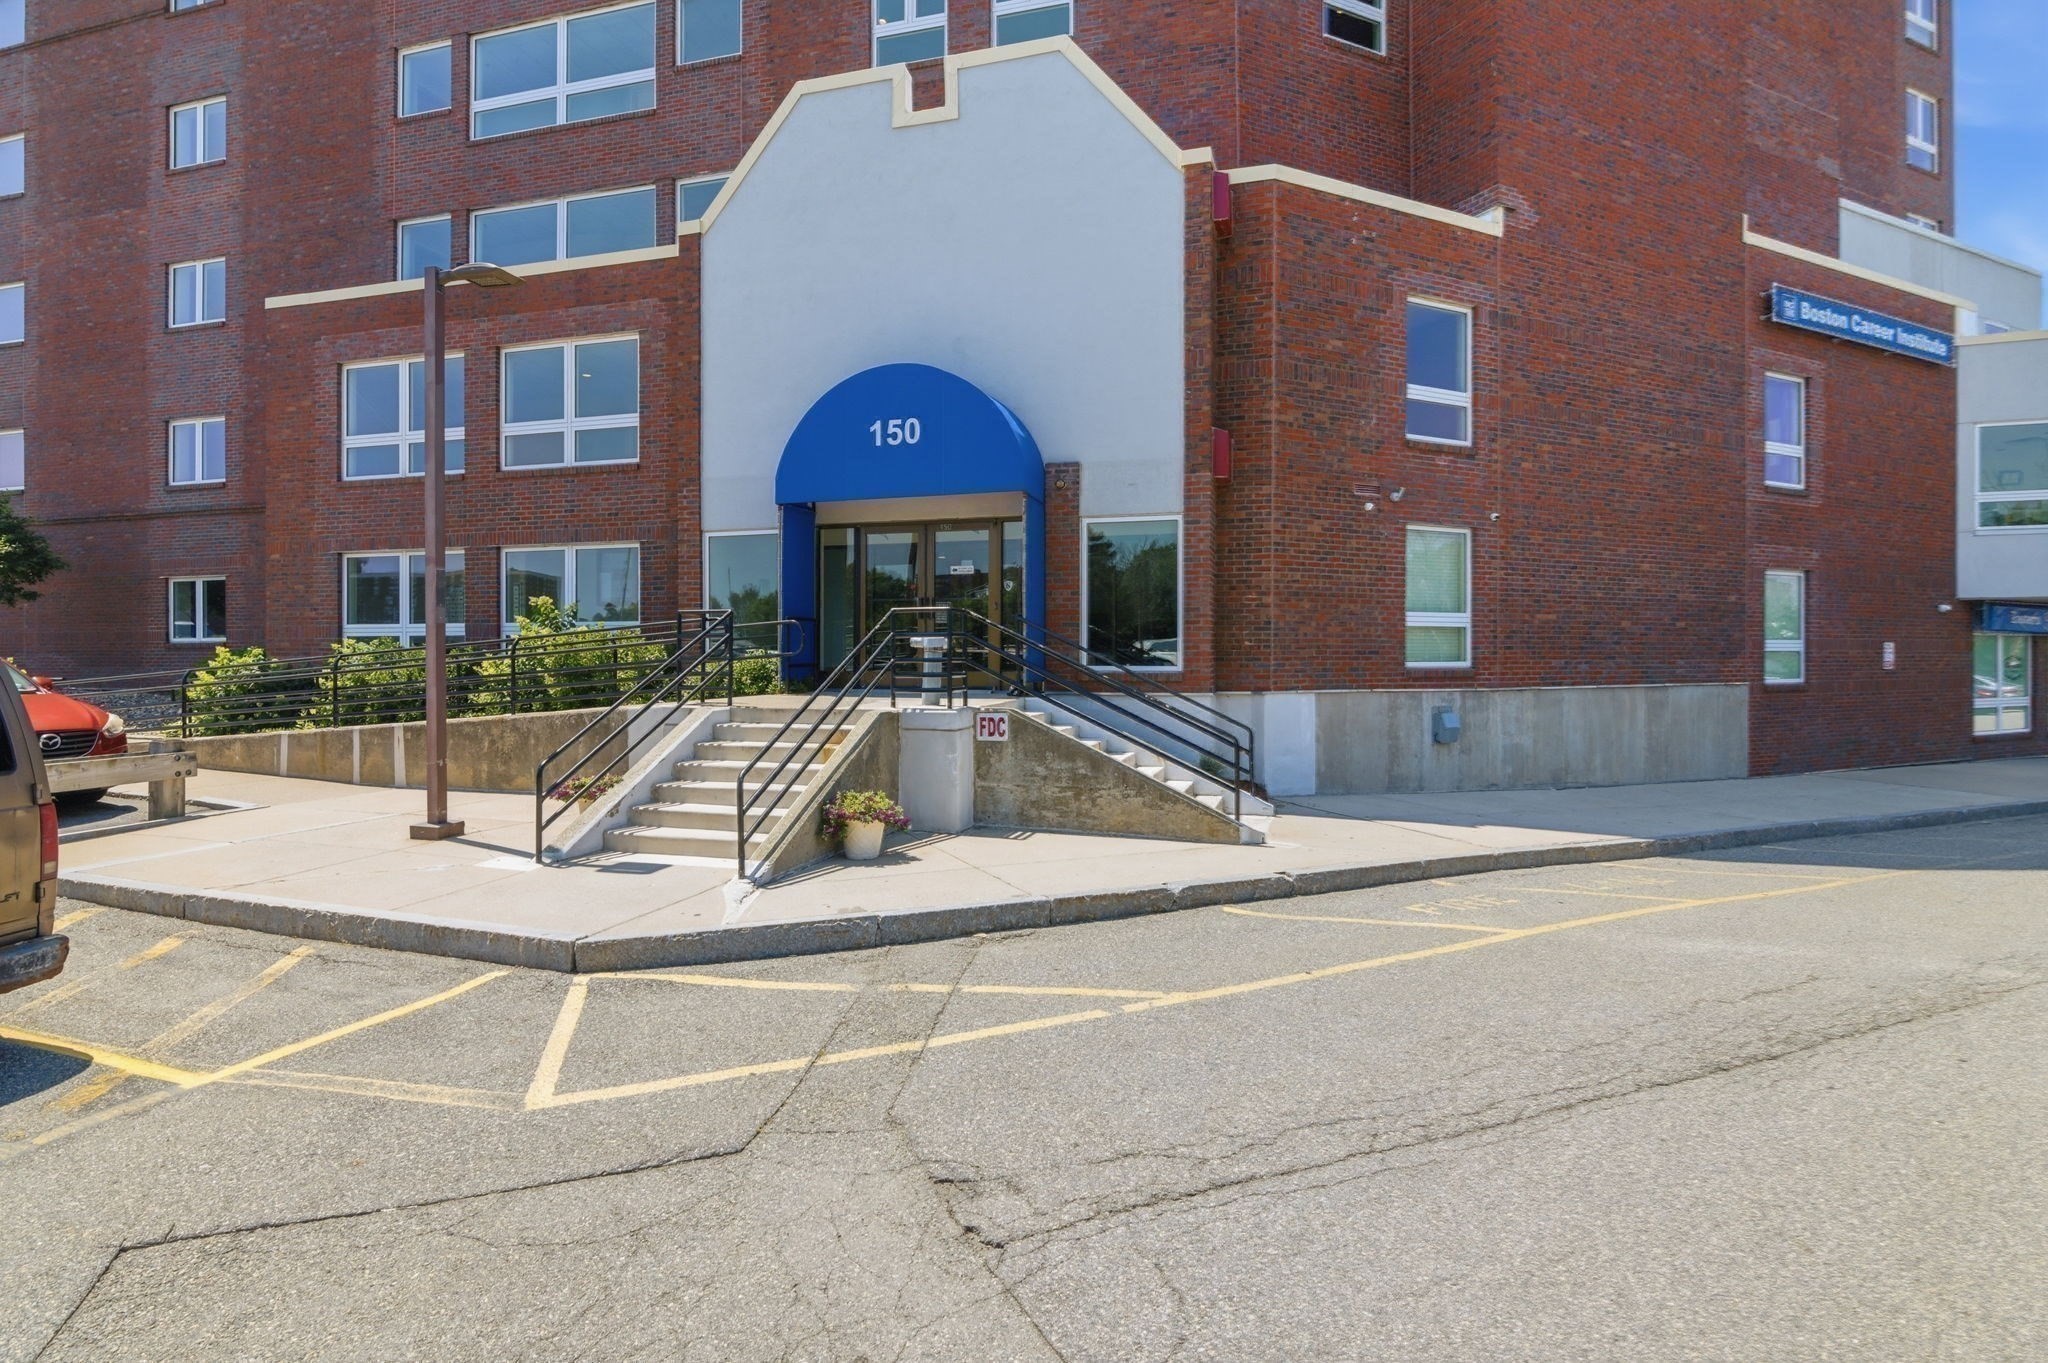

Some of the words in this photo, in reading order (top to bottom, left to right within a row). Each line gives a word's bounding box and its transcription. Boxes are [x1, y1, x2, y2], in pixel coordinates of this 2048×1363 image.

[1799, 301, 1849, 330] Boston
[1851, 314, 1896, 341] Career
[1896, 327, 1948, 356] Institute
[869, 417, 921, 447] 150
[979, 716, 1006, 738] FDC
